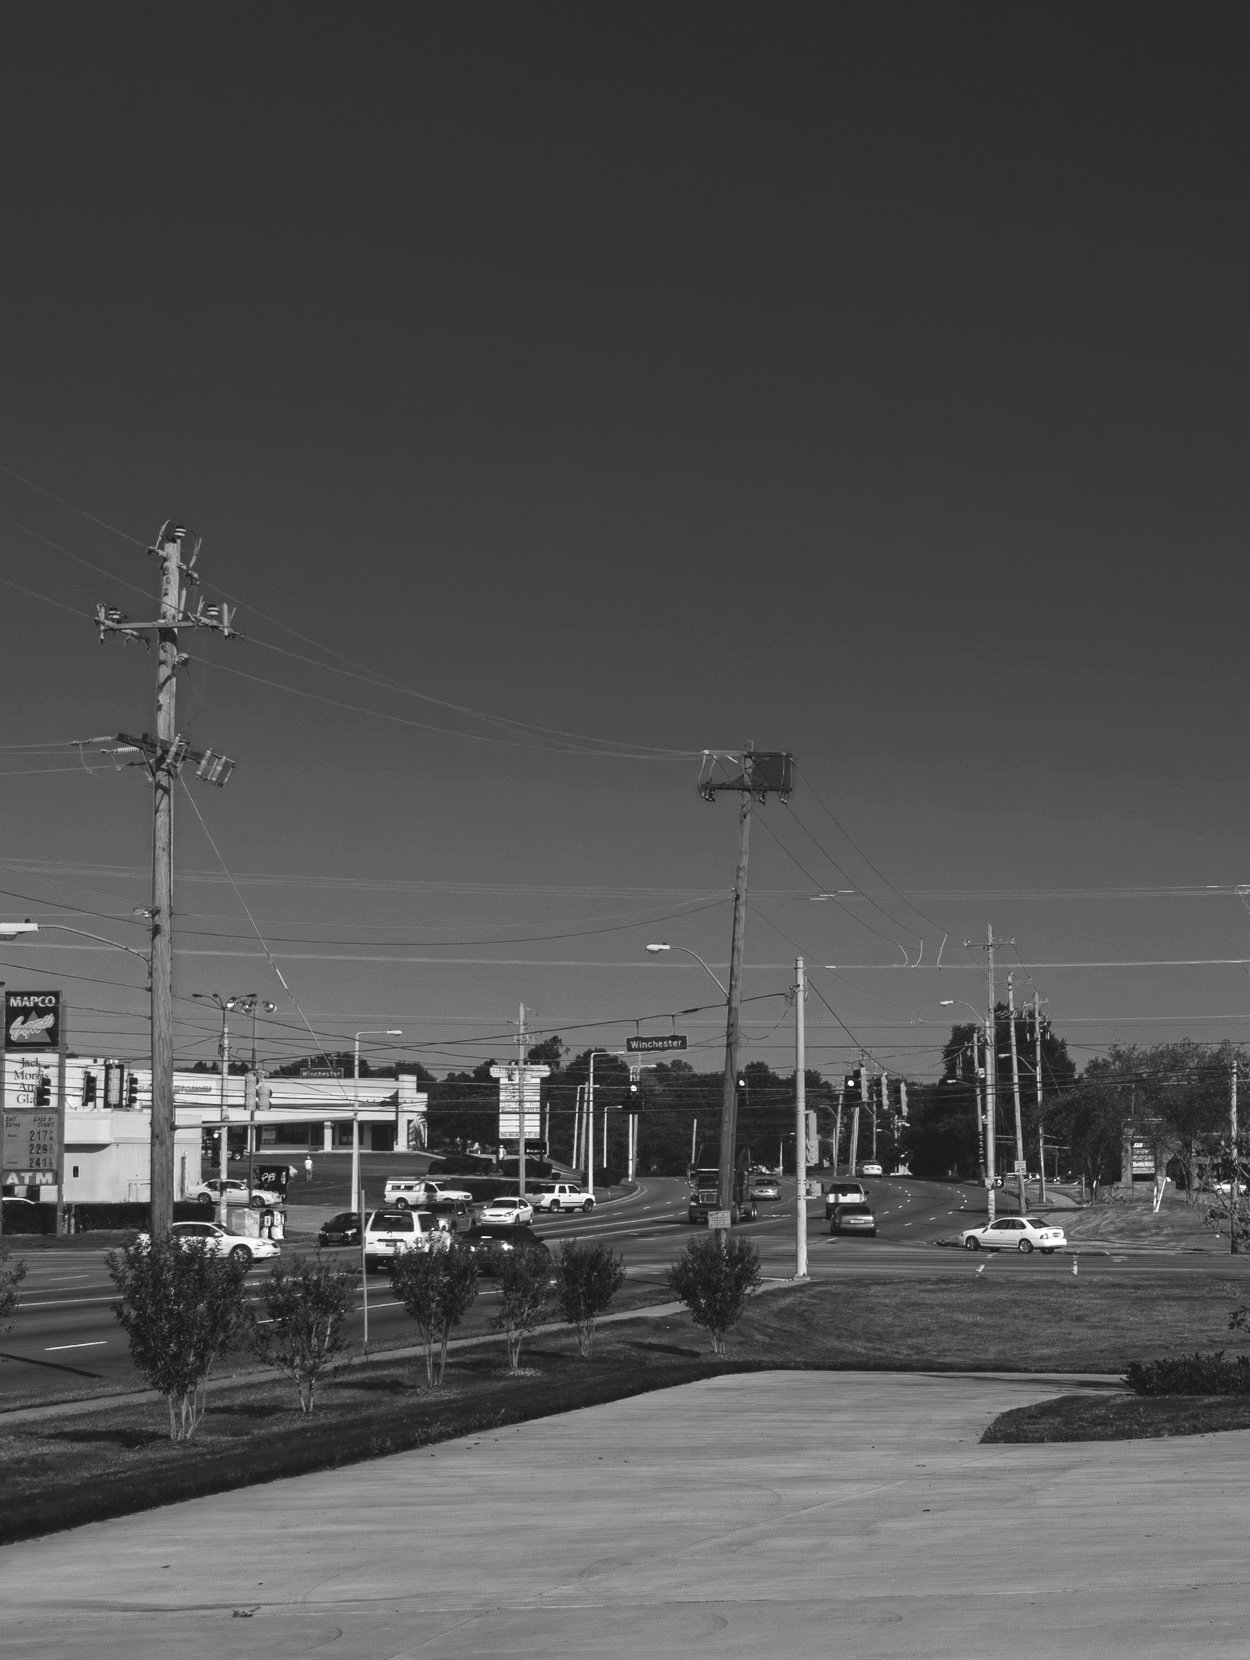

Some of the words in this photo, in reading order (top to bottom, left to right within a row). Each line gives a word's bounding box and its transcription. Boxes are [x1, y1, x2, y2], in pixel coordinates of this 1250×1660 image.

[10, 996, 56, 1007] MAPCO
[630, 1040, 682, 1048] Winchester
[17, 1094, 36, 1104] Gla
[29, 1130, 48, 1141] 217
[29, 1143, 48, 1155] 229
[29, 1157, 47, 1168] 241
[5, 1172, 53, 1185] ATM
